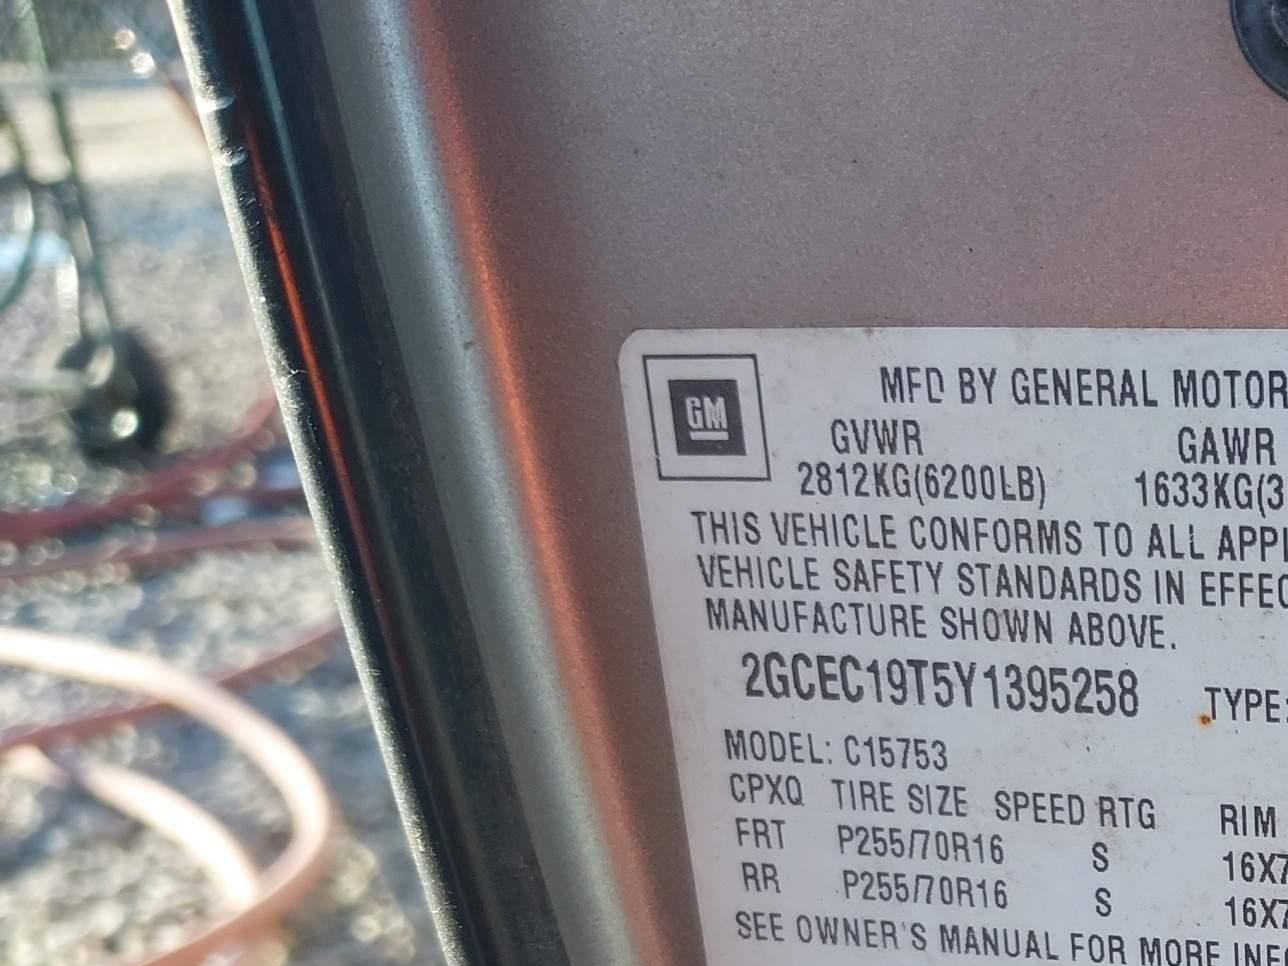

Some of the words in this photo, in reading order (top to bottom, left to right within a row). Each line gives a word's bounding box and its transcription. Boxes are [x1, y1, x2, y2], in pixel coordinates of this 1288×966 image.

[880, 366, 944, 403] MFD
[958, 368, 997, 404] BY
[1011, 368, 1158, 407] GENERAL
[685, 397, 727, 429] GM
[831, 419, 923, 455] GVWR
[1178, 426, 1276, 465] GAWR
[798, 461, 1045, 510] 2812KG(6200LB)
[690, 511, 761, 545] THIS
[770, 512, 897, 549] VEHICLE
[909, 516, 1082, 555] CONFORMS
[1094, 521, 1132, 557] TO
[1147, 523, 1204, 560] ALL
[697, 555, 820, 590] VEHICLE
[833, 558, 943, 594] SAFETY
[957, 562, 1141, 603] STANDARDS
[1155, 570, 1184, 605] IN
[705, 598, 927, 638] MANUFACTURE
[940, 606, 1052, 644] SHOWN
[1068, 612, 1176, 649] ABOVE.
[742, 652, 1139, 717] 2GCEC19T5Y1395258
[724, 729, 832, 764] MODEL:
[844, 735, 947, 771] C15753
[730, 773, 804, 806] CPXQ
[831, 779, 895, 812] TIRE
[907, 784, 967, 817] SIZE
[995, 790, 1085, 825] SPEED
[1098, 796, 1155, 829] RTG
[1220, 804, 1276, 838] RIM
[736, 817, 785, 849] FRT
[837, 825, 1003, 864] P255/70R16
[1092, 842, 1109, 872] S
[741, 862, 780, 893] RR
[843, 870, 1008, 909] P255/70R16
[1095, 888, 1111, 917] S
[736, 911, 784, 941] SEE
[796, 915, 927, 951] OWNER'S
[940, 924, 1059, 960] MANUAL
[1070, 933, 1127, 965] FOR
